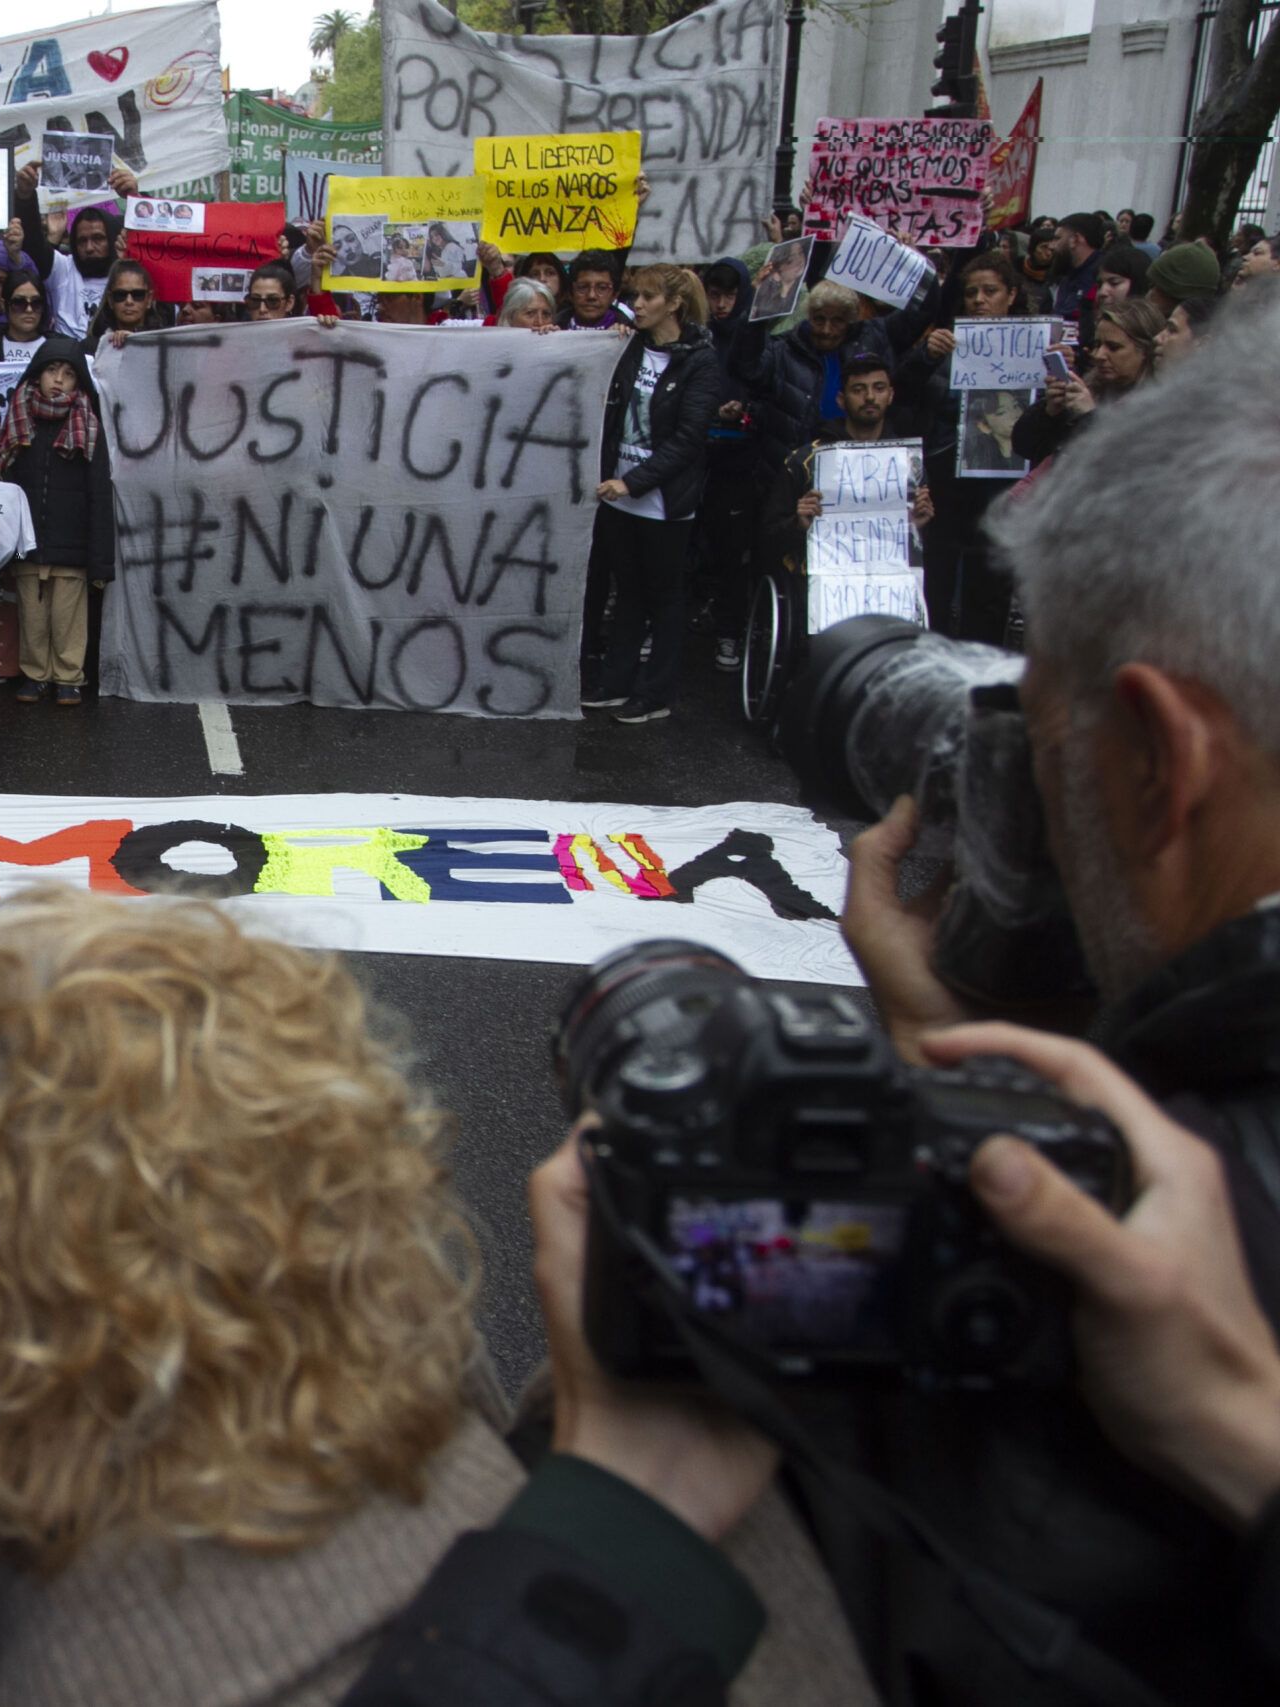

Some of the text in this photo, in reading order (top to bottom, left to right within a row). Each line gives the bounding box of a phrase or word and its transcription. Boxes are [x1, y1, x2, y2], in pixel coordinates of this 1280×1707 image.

[395, 54, 504, 138] POR
[288, 127, 317, 142] por
[46, 151, 102, 165] JUSTICIA
[491, 143, 518, 170] LA
[857, 154, 972, 187] QUEREMOS
[496, 172, 618, 199] DE LOS NARCOS
[500, 205, 604, 238] AVANZA
[831, 223, 921, 298] JUSTICIA
[953, 372, 977, 387] LAS
[817, 453, 904, 506] LARA
[815, 516, 908, 569] BRENDA
[153, 602, 566, 717] MENOS
